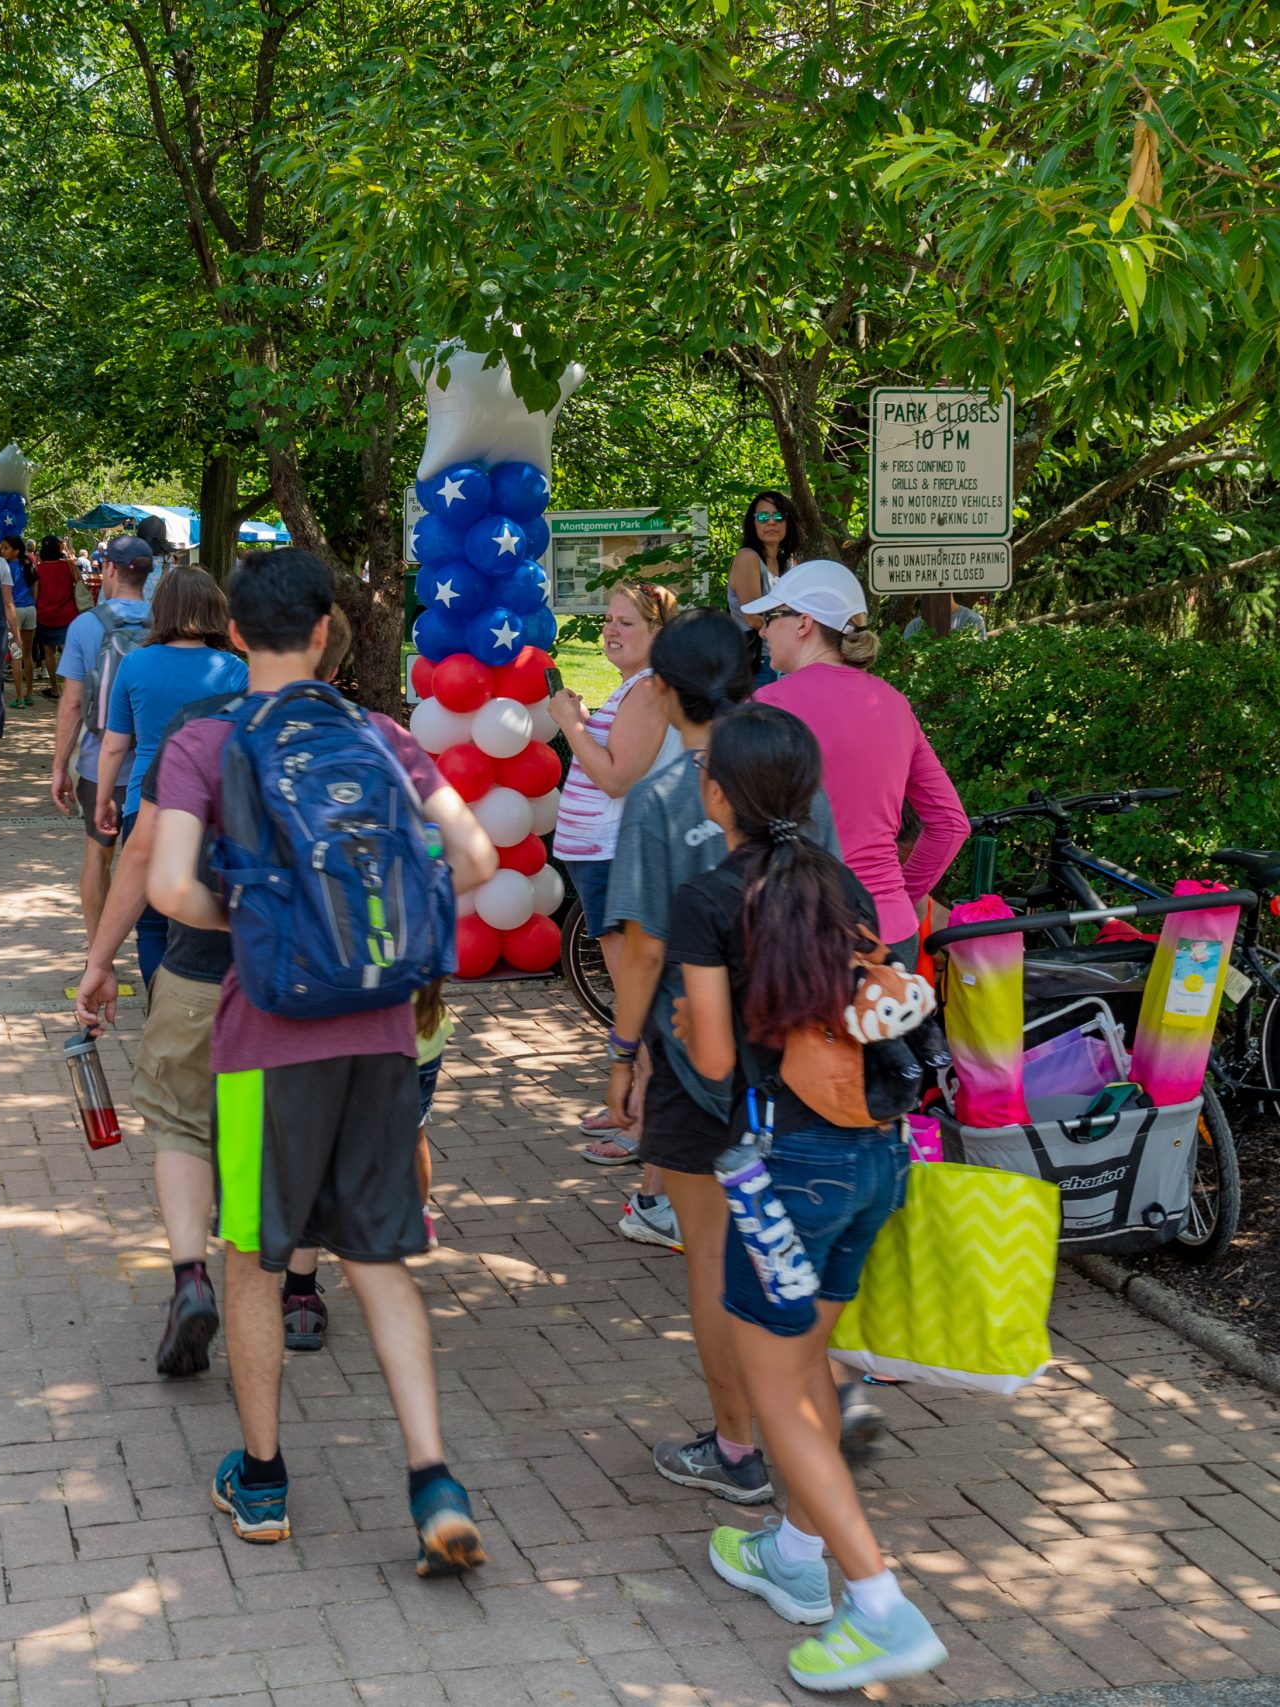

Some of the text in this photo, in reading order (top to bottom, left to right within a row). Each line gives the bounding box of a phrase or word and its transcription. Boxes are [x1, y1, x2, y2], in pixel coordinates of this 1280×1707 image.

[884, 403, 1000, 423] PARK CLOSES
[915, 430, 970, 450] 10 PM
[892, 461, 965, 472] FIRES CONFINED TO
[892, 479, 978, 490] GRILLS & FIREPLACES
[892, 496, 1003, 507] NO MOTORIZED VEHICLES
[892, 513, 988, 525] BEYOND PARKING LOT
[560, 521, 640, 531] Montgomery Park
[888, 552, 1005, 567] NO UNAUTHORIZED PARKING
[889, 568, 984, 582] WHEN PARK IS CLOSED
[1058, 1168, 1126, 1190] chariot
